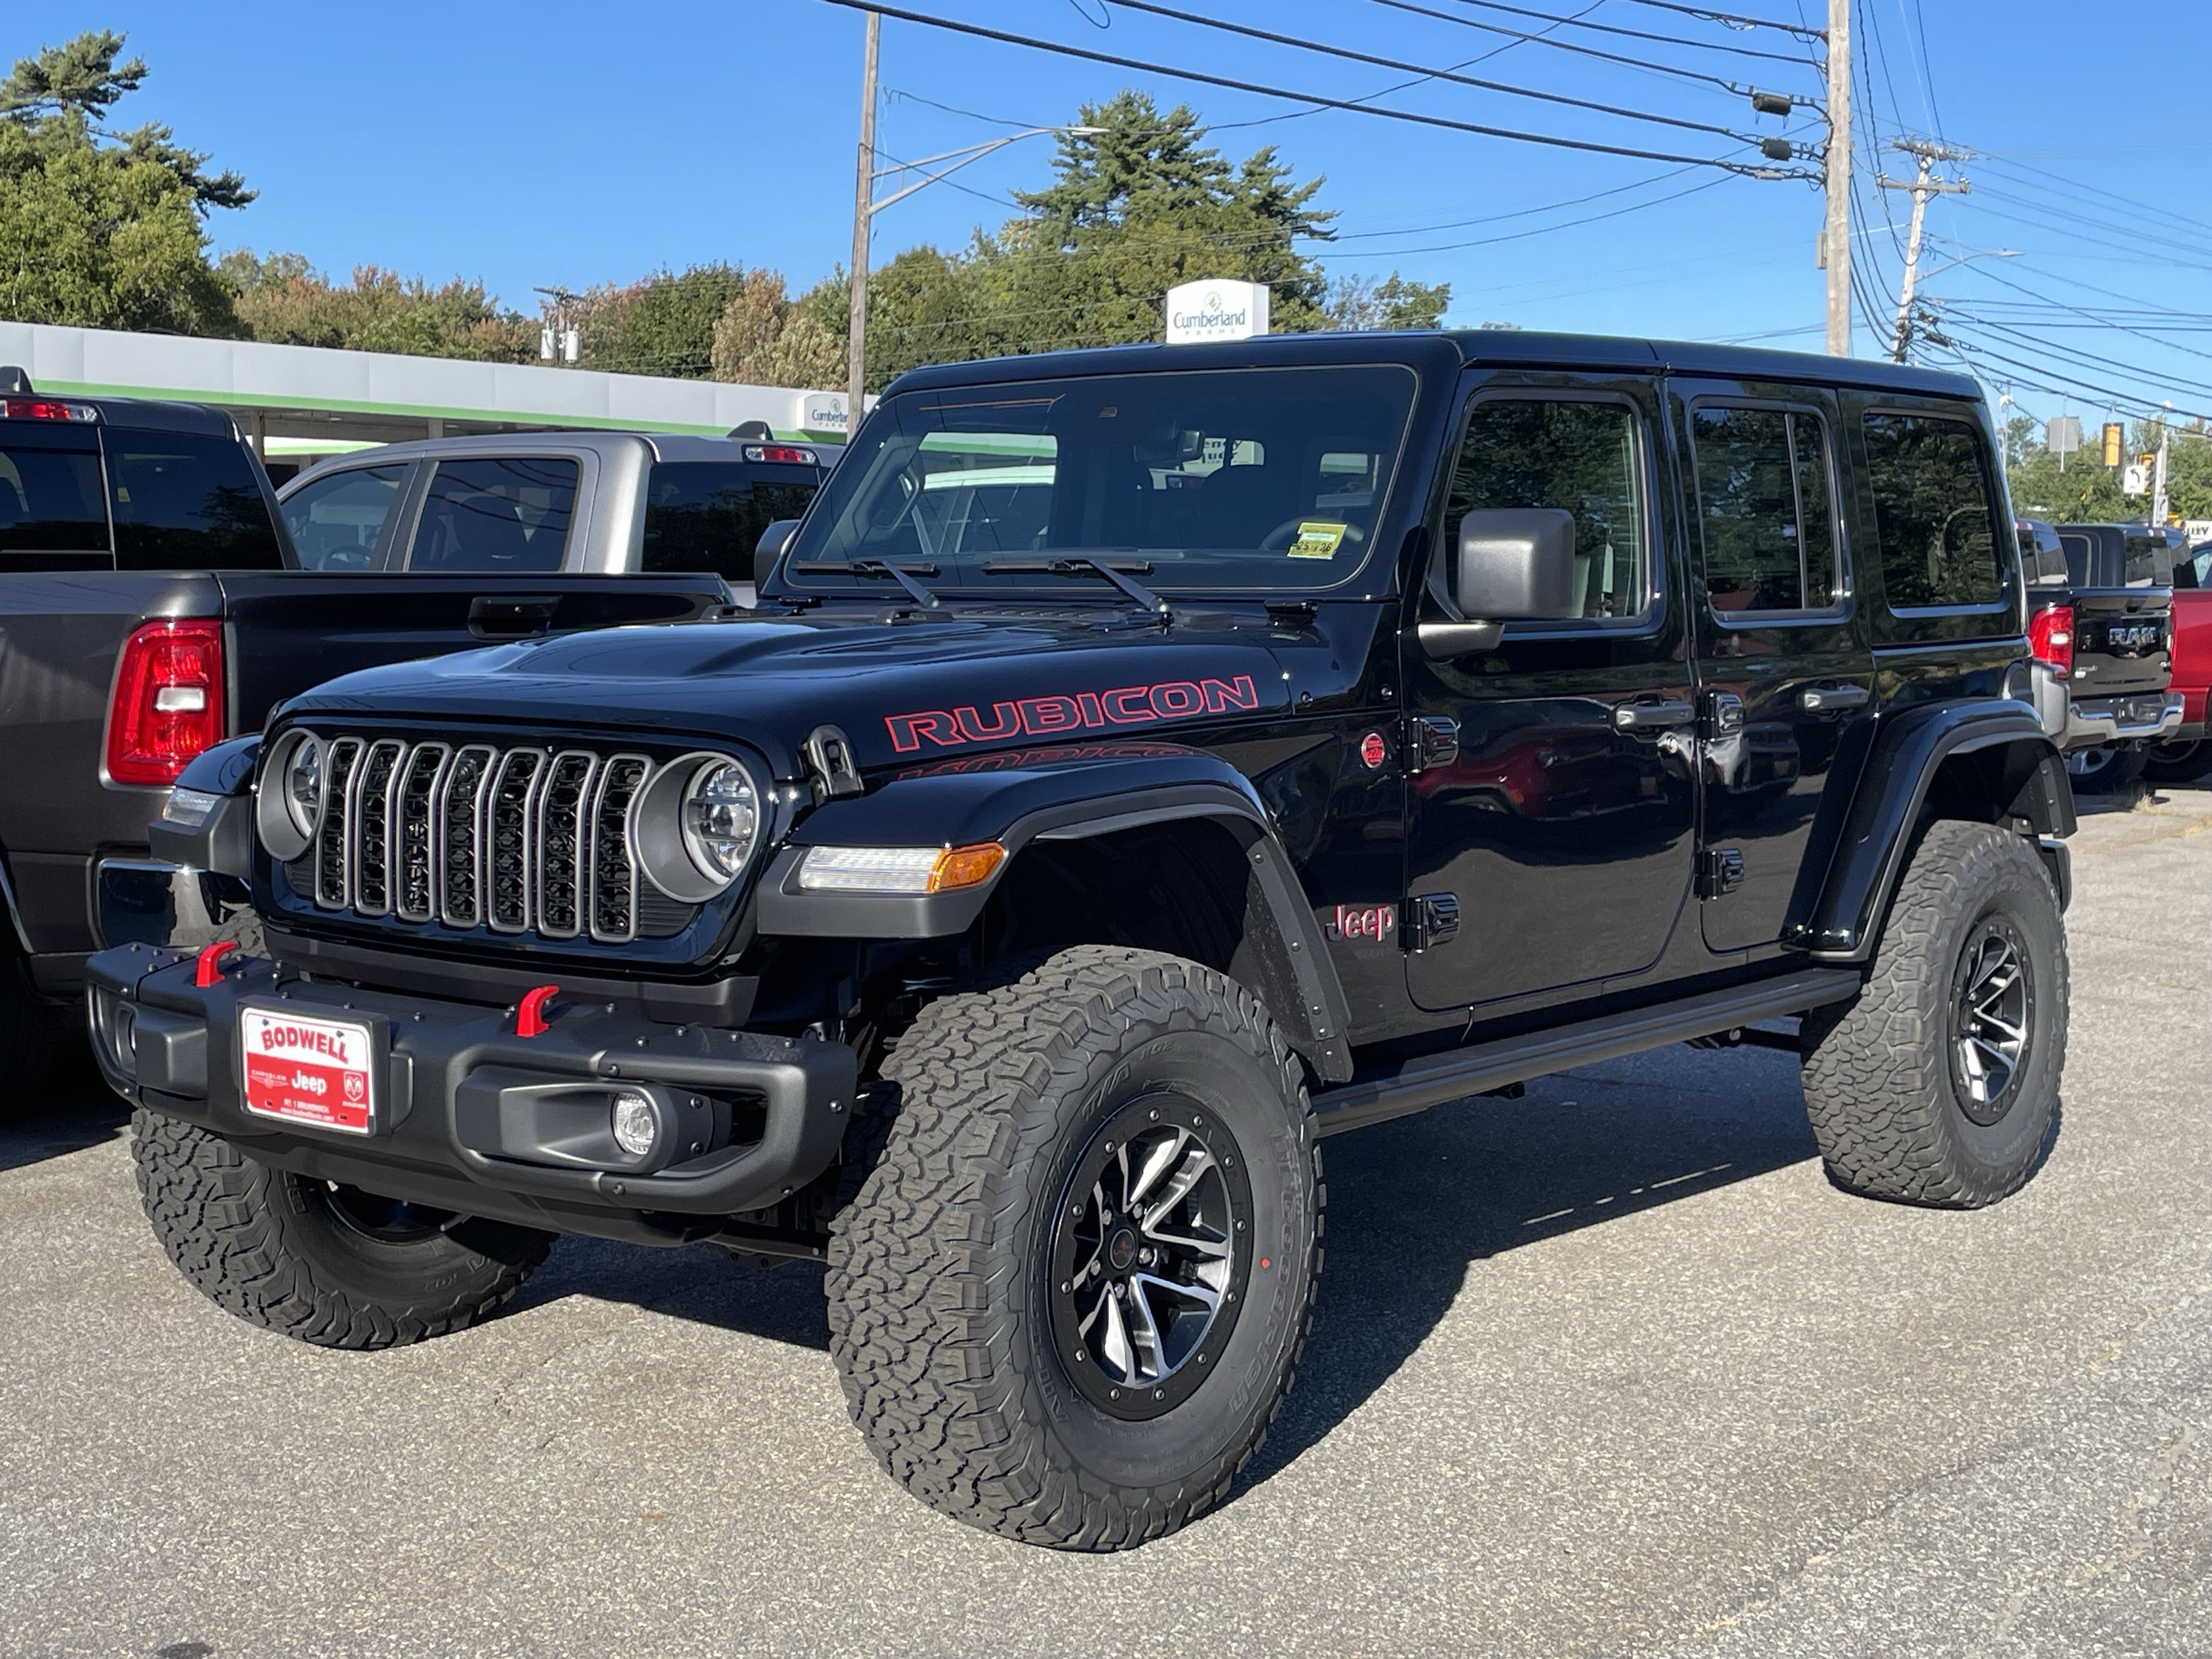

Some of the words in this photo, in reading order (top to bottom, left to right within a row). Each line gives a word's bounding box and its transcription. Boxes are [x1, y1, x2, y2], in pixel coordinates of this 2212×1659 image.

[1173, 308, 1245, 329] Cumberland
[884, 674, 1259, 753] RUBICON
[1324, 904, 1395, 942] Jeep
[261, 1026, 349, 1065] BODWELL
[291, 1069, 328, 1096] Jeep
